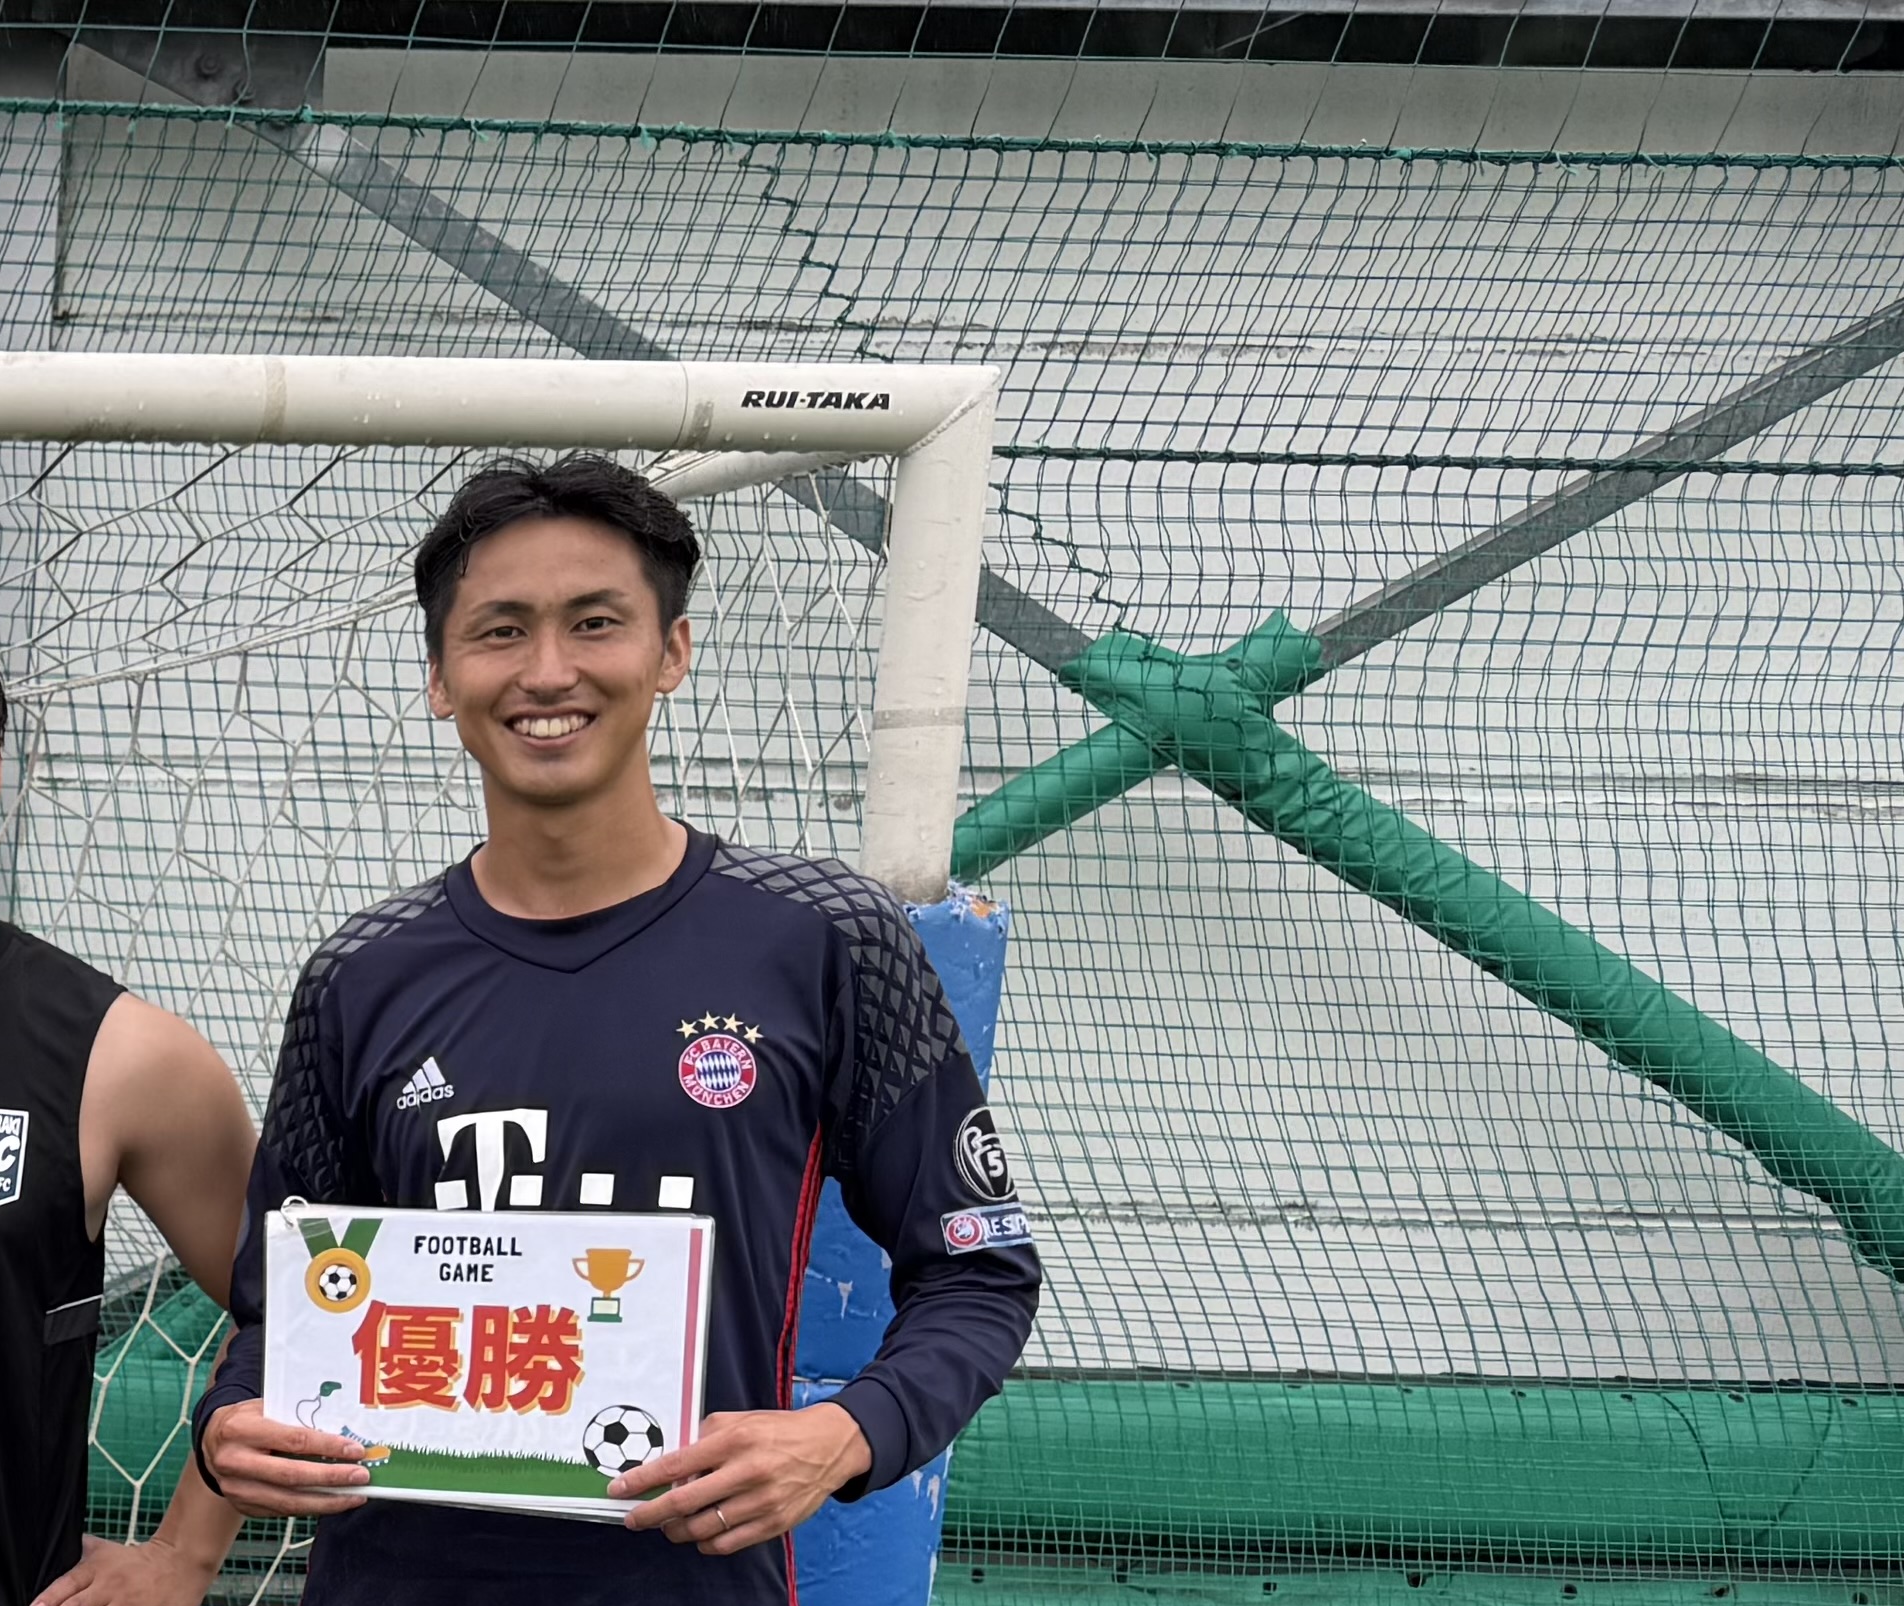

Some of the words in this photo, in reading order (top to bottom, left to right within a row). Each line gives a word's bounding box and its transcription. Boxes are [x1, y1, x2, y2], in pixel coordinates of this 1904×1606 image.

[741, 390, 890, 410] RUI-TAKA
[683, 1047, 700, 1066] FC
[700, 1038, 752, 1070] BAYERN
[396, 1083, 455, 1110] adidas
[436, 1108, 548, 1212] T
[987, 1150, 1005, 1178] 5
[414, 1235, 523, 1257] FOOTBALL
[439, 1263, 494, 1283] GAME
[352, 1300, 585, 1415] 優勝
